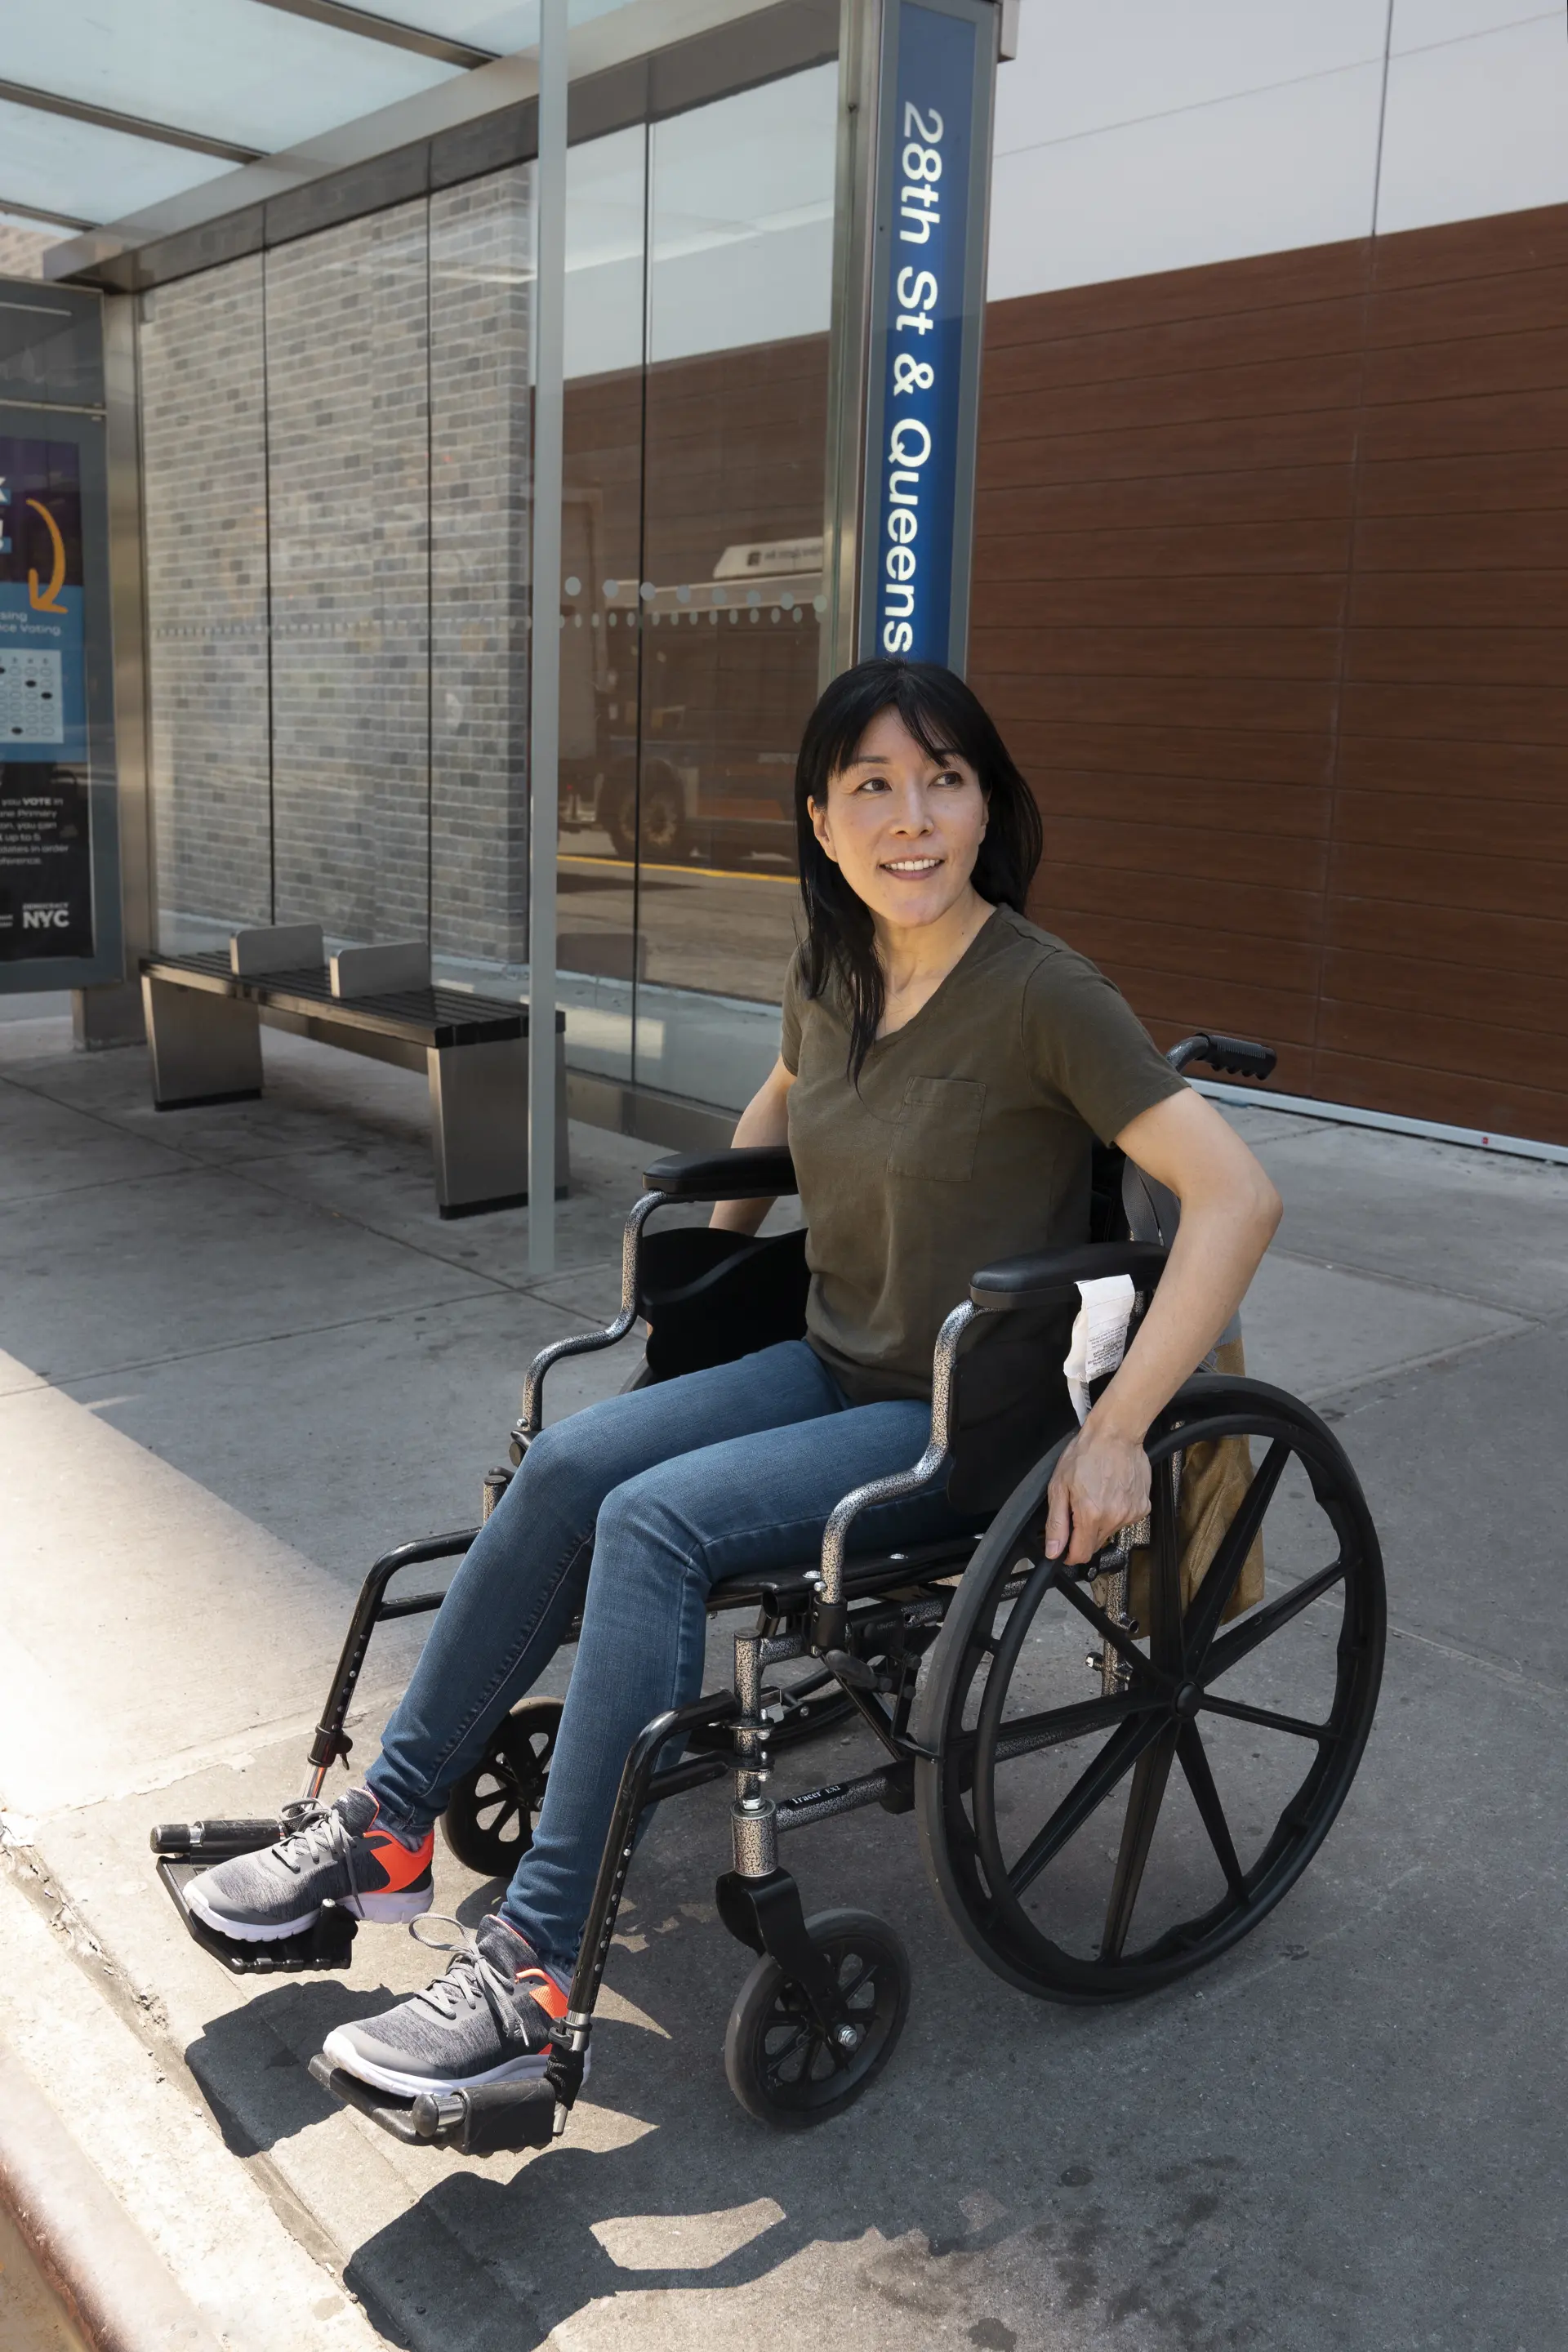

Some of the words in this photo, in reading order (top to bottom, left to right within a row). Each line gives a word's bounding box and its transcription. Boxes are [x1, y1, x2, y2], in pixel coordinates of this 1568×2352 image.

[899, 100, 944, 244] 28th
[896, 266, 938, 336] St
[893, 353, 934, 396] &
[883, 418, 931, 653] Queens
[20, 623, 61, 636] Voting
[22, 797, 51, 806] VOTE
[23, 910, 69, 929] NYC
[791, 1791, 822, 1804] Tracer
